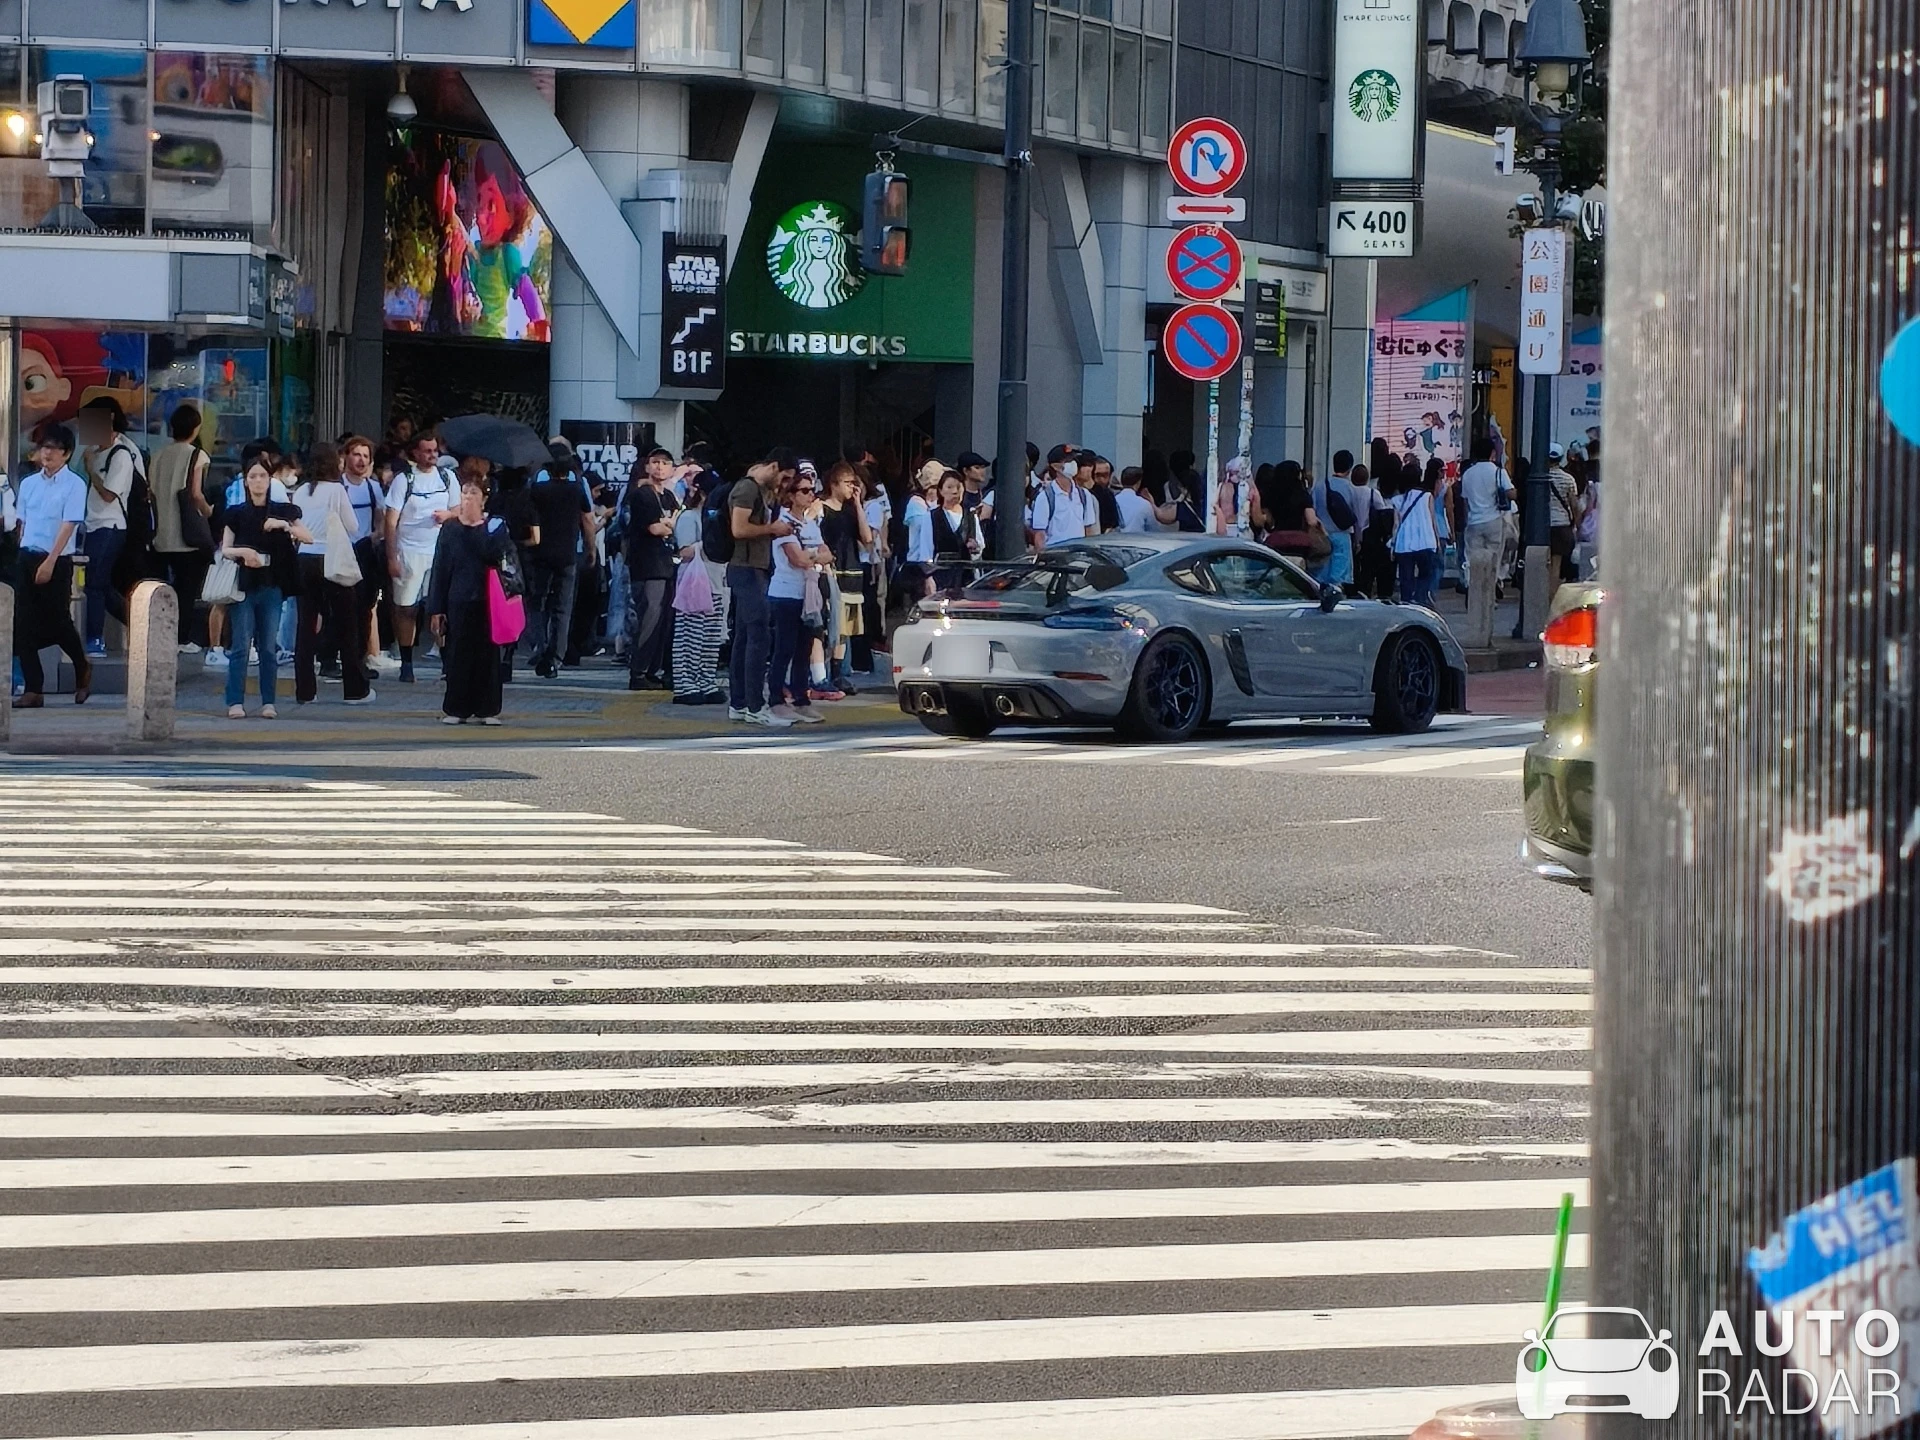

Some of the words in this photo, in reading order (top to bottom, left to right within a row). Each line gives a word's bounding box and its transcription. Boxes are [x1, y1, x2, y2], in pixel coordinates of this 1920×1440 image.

[1343, 14, 1372, 22] SHARE
[1375, 14, 1412, 22] LOUNGE
[1363, 210, 1407, 234] 400
[1193, 227, 1219, 238] 1-20
[1363, 239, 1406, 249] SEATS
[667, 255, 720, 272] STAR
[668, 269, 720, 286] WARS
[1527, 239, 1552, 362] 公園通り
[730, 331, 906, 357] STARBUCKS
[673, 350, 713, 374] B1F
[576, 443, 639, 464] STAR
